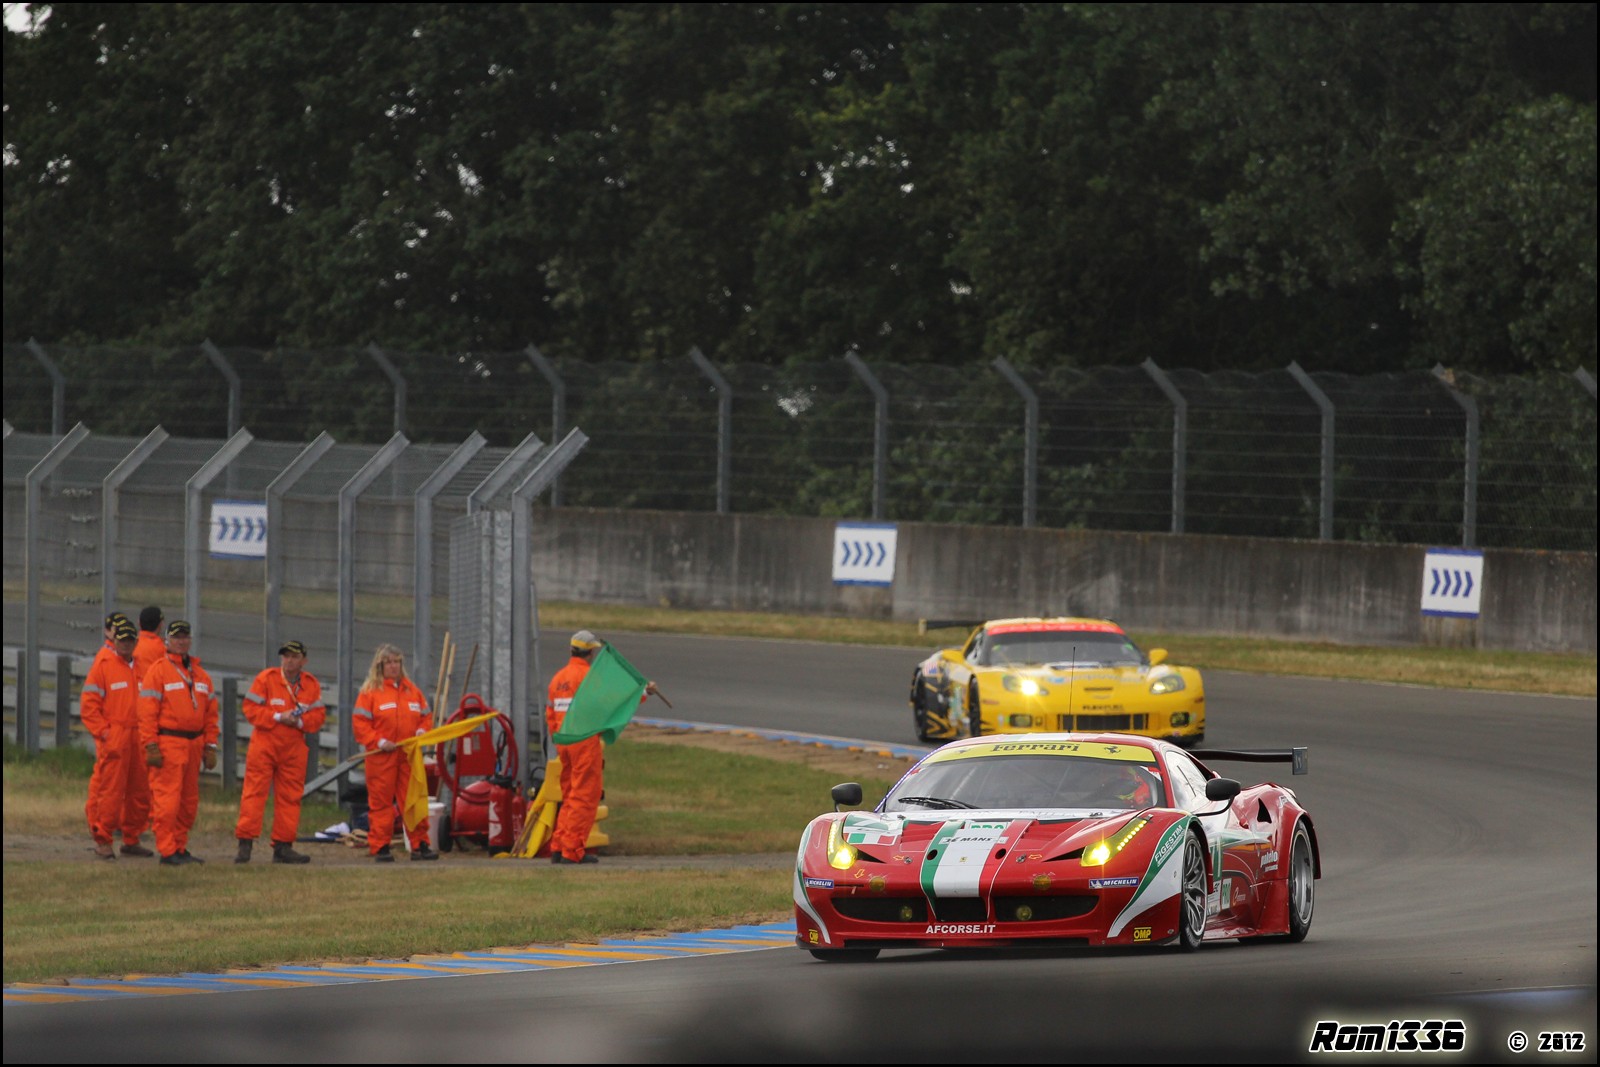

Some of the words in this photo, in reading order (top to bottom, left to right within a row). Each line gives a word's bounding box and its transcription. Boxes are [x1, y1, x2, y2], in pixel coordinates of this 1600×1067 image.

[991, 743, 1081, 752] Ferrari
[1154, 825, 1183, 861] FIGESTIM
[925, 925, 996, 934] AFCORSE.IT
[1134, 930, 1152, 939] OMP
